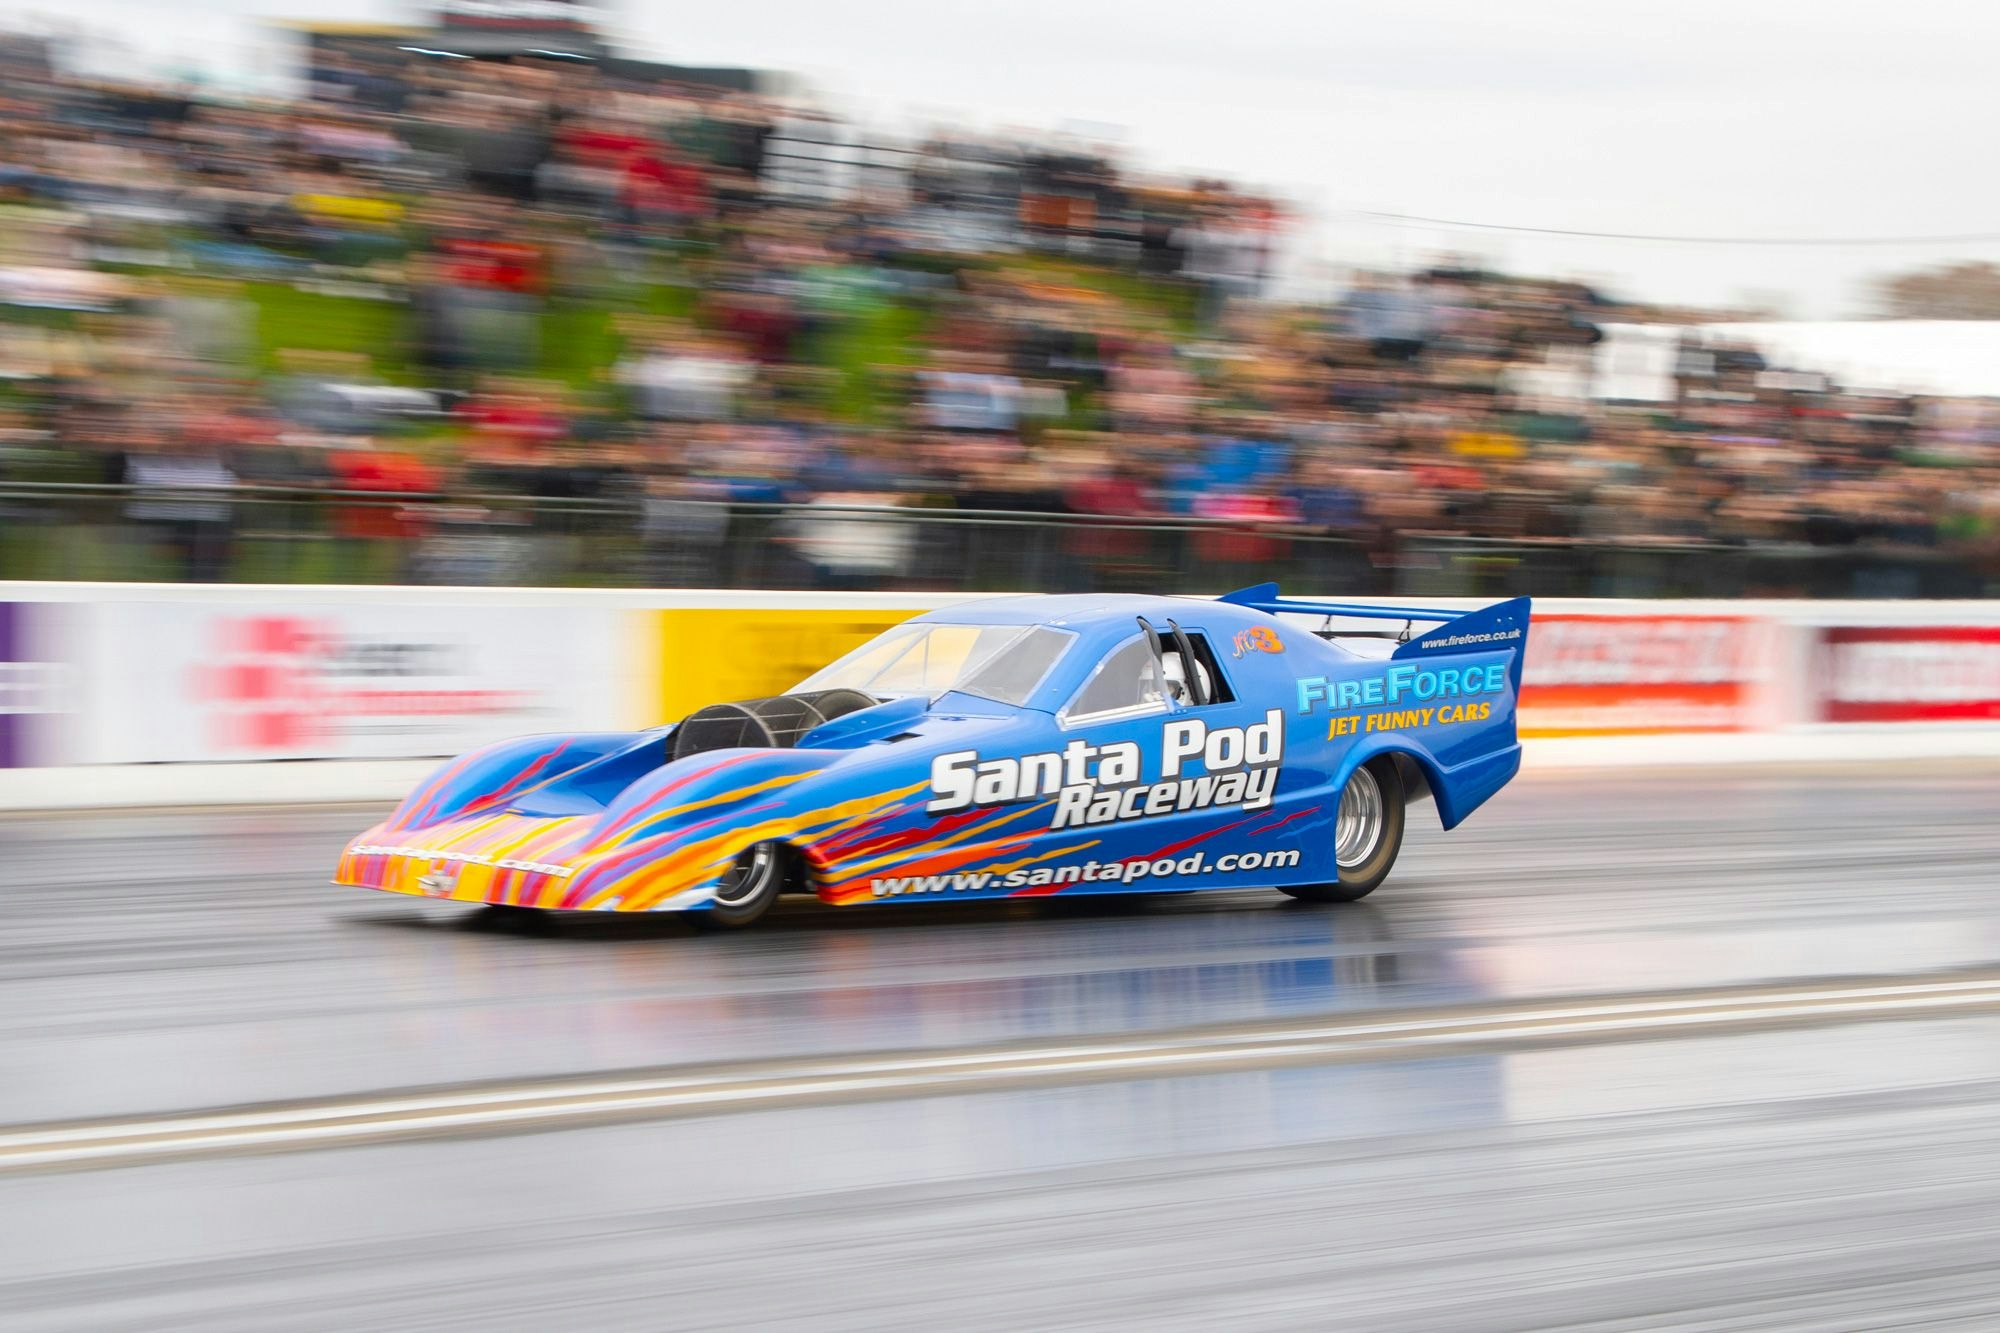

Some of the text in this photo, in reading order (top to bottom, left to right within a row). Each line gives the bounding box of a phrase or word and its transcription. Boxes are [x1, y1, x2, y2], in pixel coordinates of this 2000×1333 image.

[1421, 628, 1521, 649] www.fireforce.co.uk
[1327, 701, 1490, 741] JET FUNNY CARS
[925, 708, 1284, 813] Santa Pod
[1049, 766, 1280, 831] Raceway
[870, 846, 1301, 897] www.santapod.com
